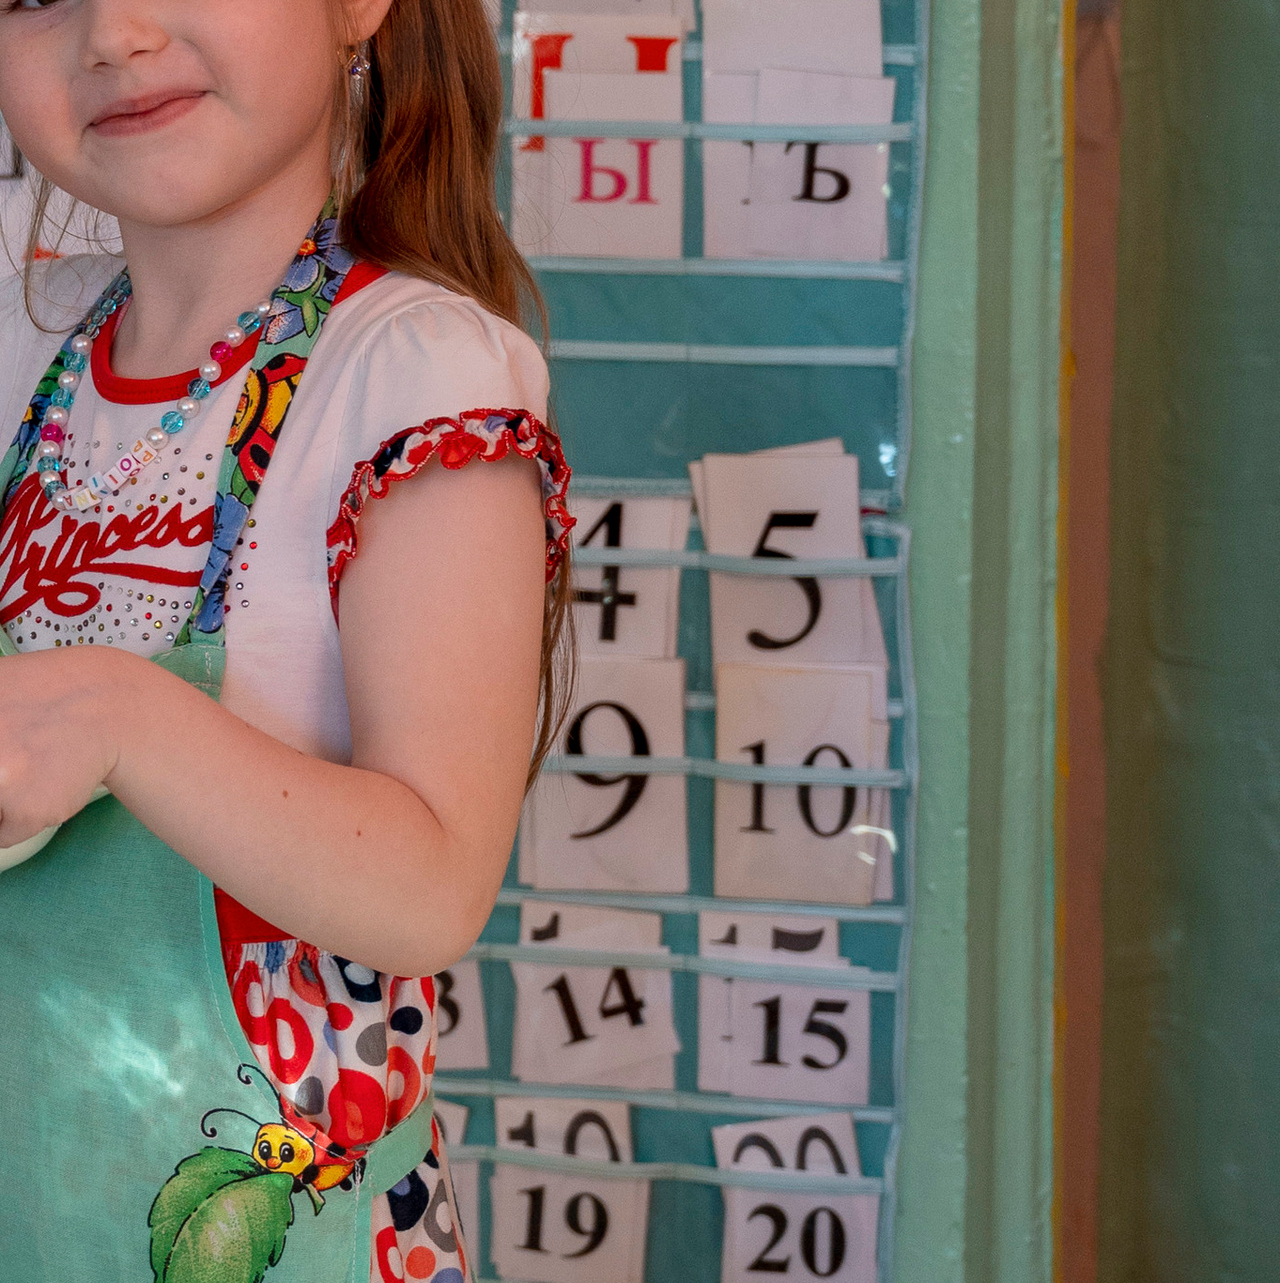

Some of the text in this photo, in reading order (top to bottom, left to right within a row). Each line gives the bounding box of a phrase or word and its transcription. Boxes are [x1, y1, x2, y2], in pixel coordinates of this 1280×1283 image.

[572, 502, 822, 650] 4 5
[565, 699, 858, 842] 9 10
[543, 965, 647, 1048] 14
[751, 994, 851, 1071] 15
[515, 1182, 848, 1278] 19 20
